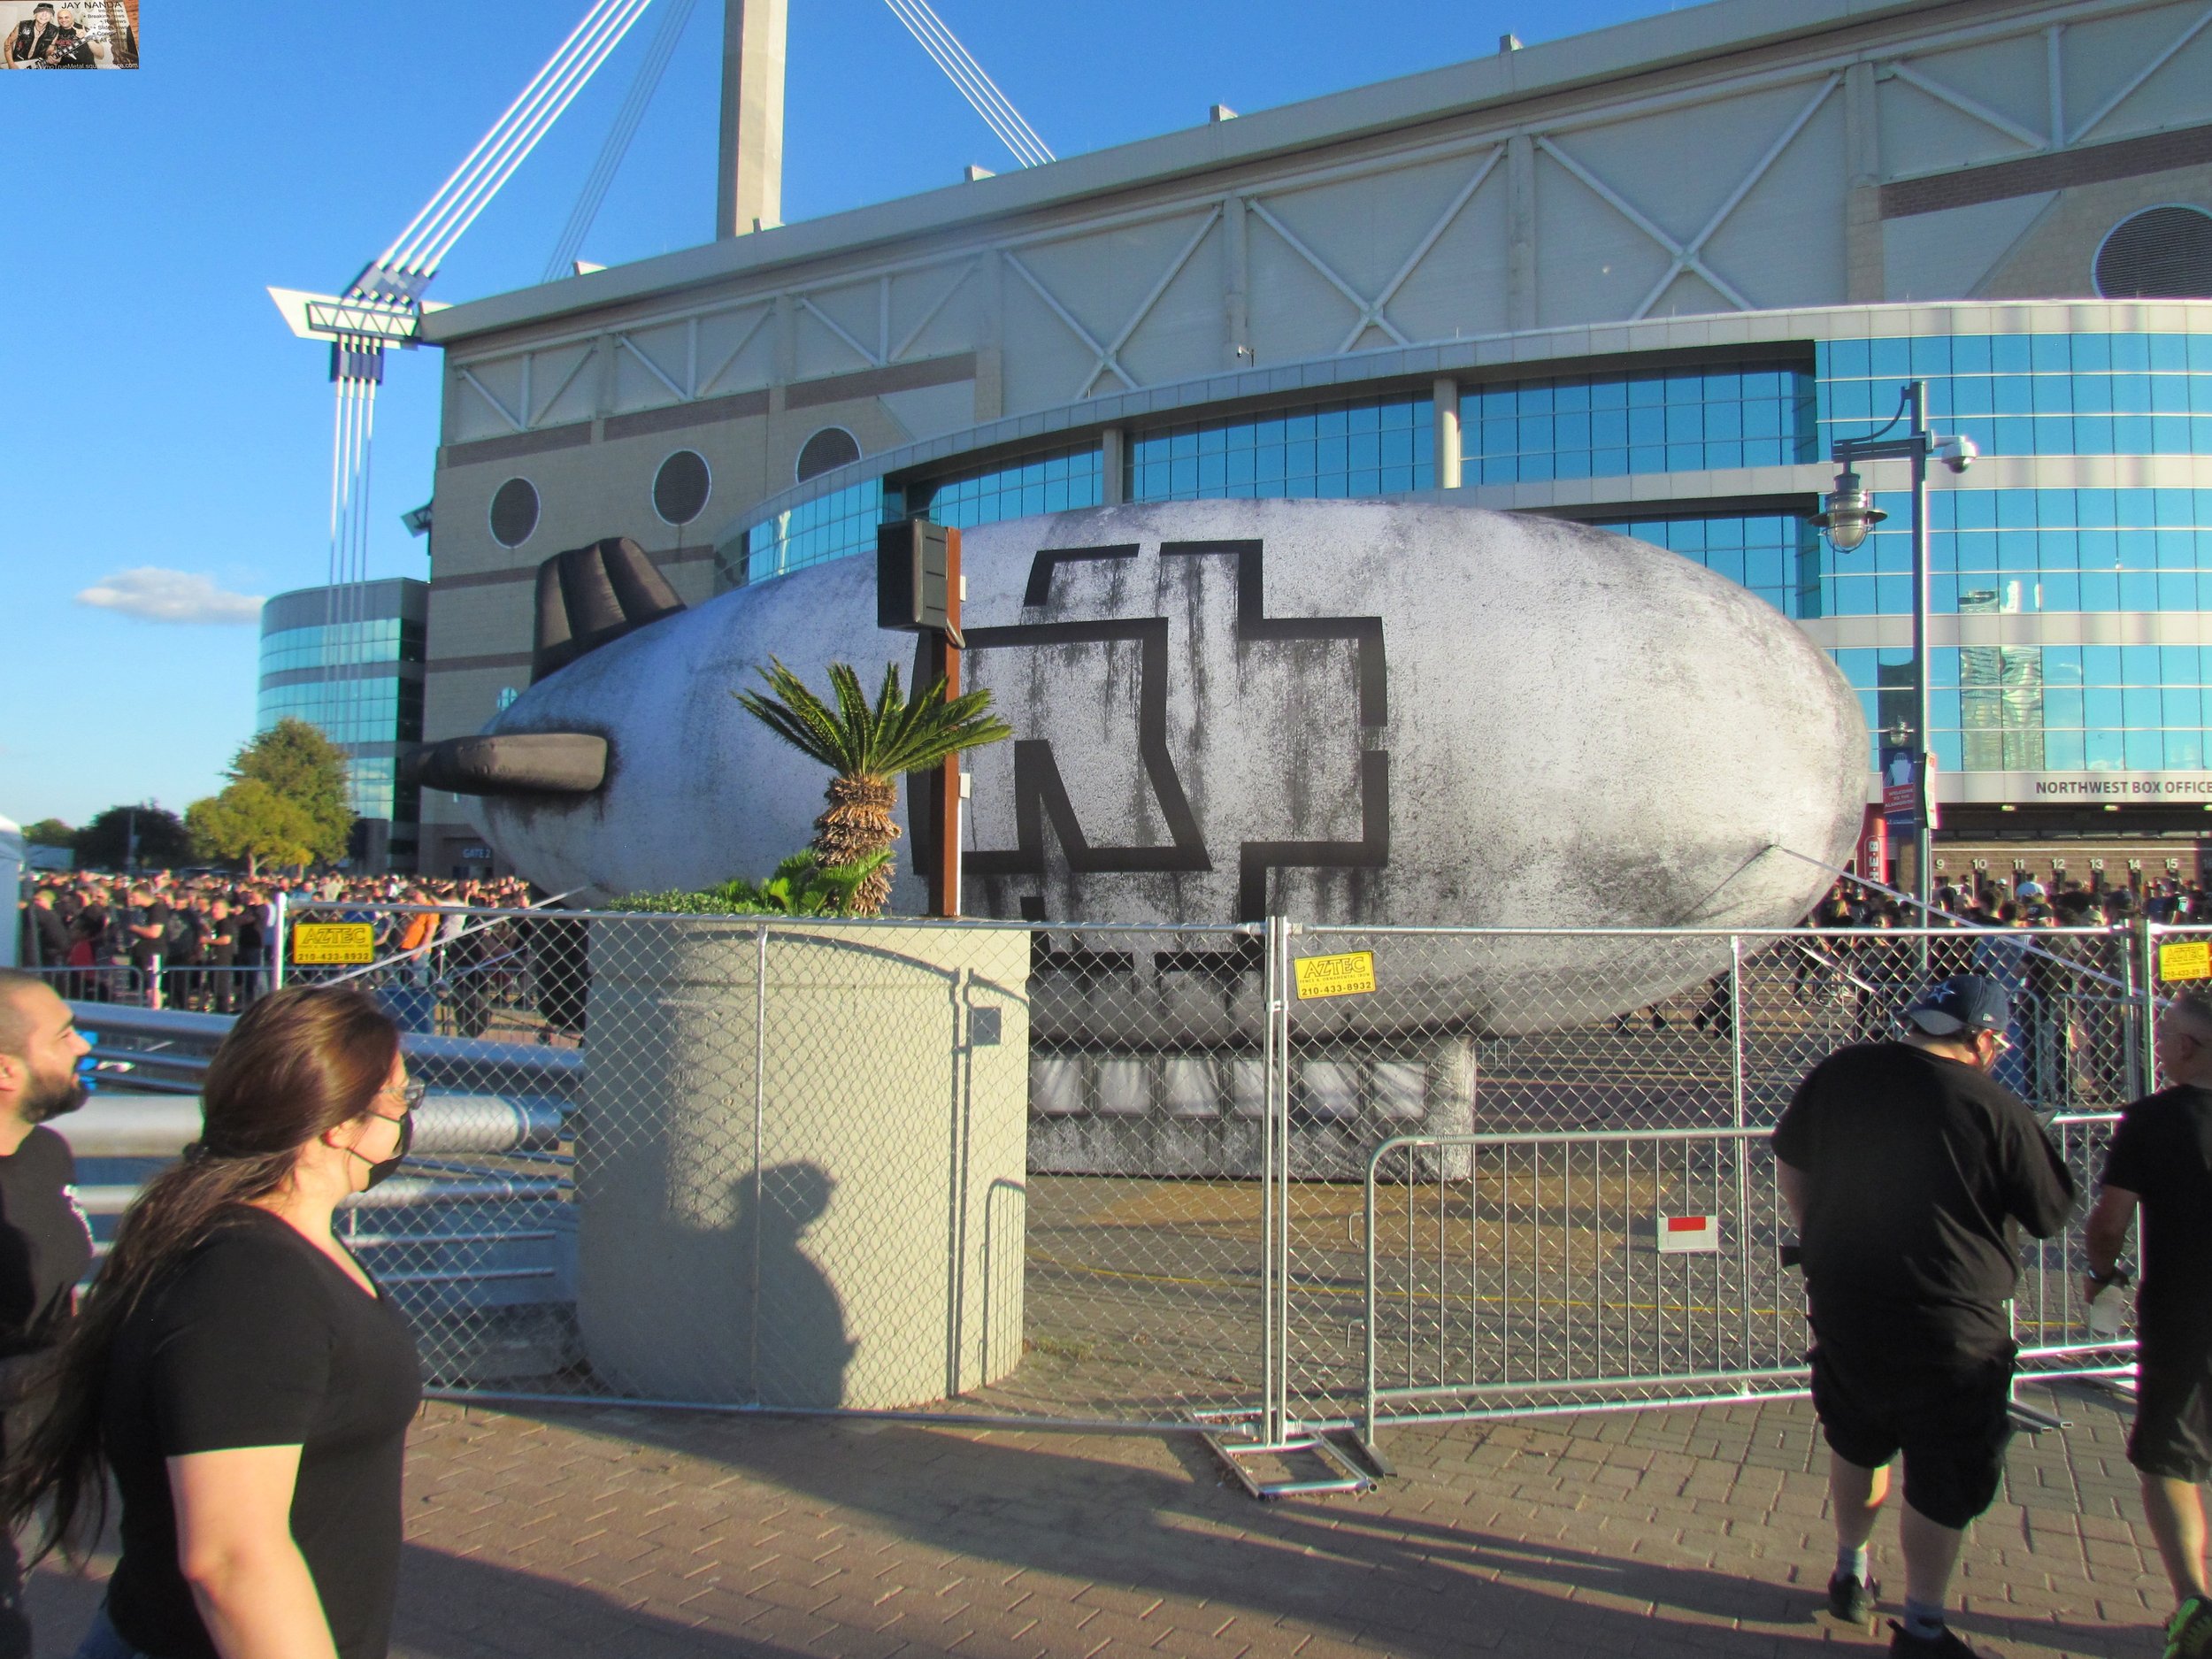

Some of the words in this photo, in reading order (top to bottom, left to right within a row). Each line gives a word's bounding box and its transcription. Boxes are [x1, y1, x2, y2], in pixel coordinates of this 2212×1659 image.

[2036, 781, 2128, 794] NORTHWEST
[2131, 781, 2161, 794] BOX
[2164, 781, 2212, 794] OFFICE
[464, 849, 483, 858] GATE
[485, 849, 491, 858] 2
[1935, 858, 1945, 870] 9
[1972, 858, 1987, 869] 10
[2013, 858, 2025, 869] 11
[2052, 858, 2066, 869] 12
[2089, 858, 2104, 869] 13
[2127, 858, 2141, 869] 14
[2165, 858, 2178, 869] 15
[303, 927, 365, 944] AZTEC
[2165, 946, 2205, 963] AZTEC
[1303, 956, 1365, 979] AZTEC
[1302, 981, 1371, 996] 210-433-8932
